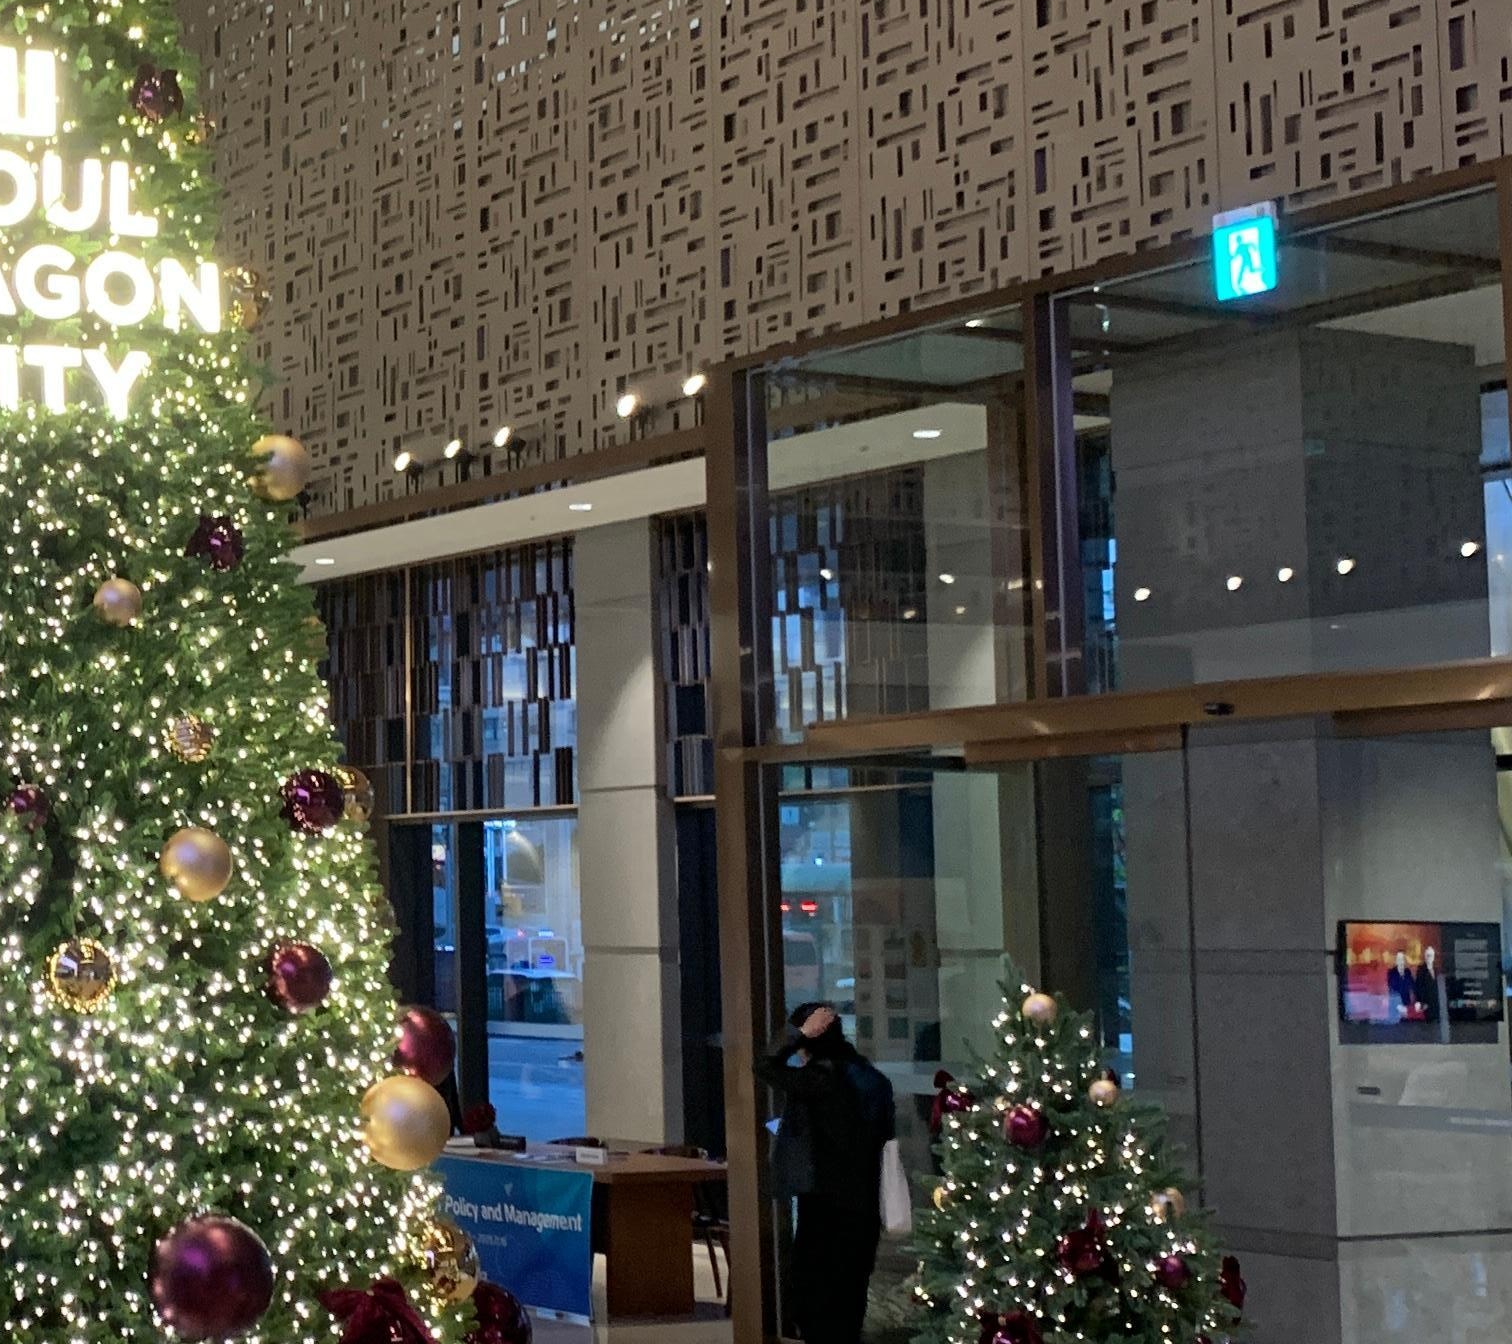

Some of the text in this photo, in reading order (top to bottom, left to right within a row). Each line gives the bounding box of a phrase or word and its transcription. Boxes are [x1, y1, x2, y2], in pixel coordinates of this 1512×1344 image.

[444, 1195, 583, 1232] Policy and Management
